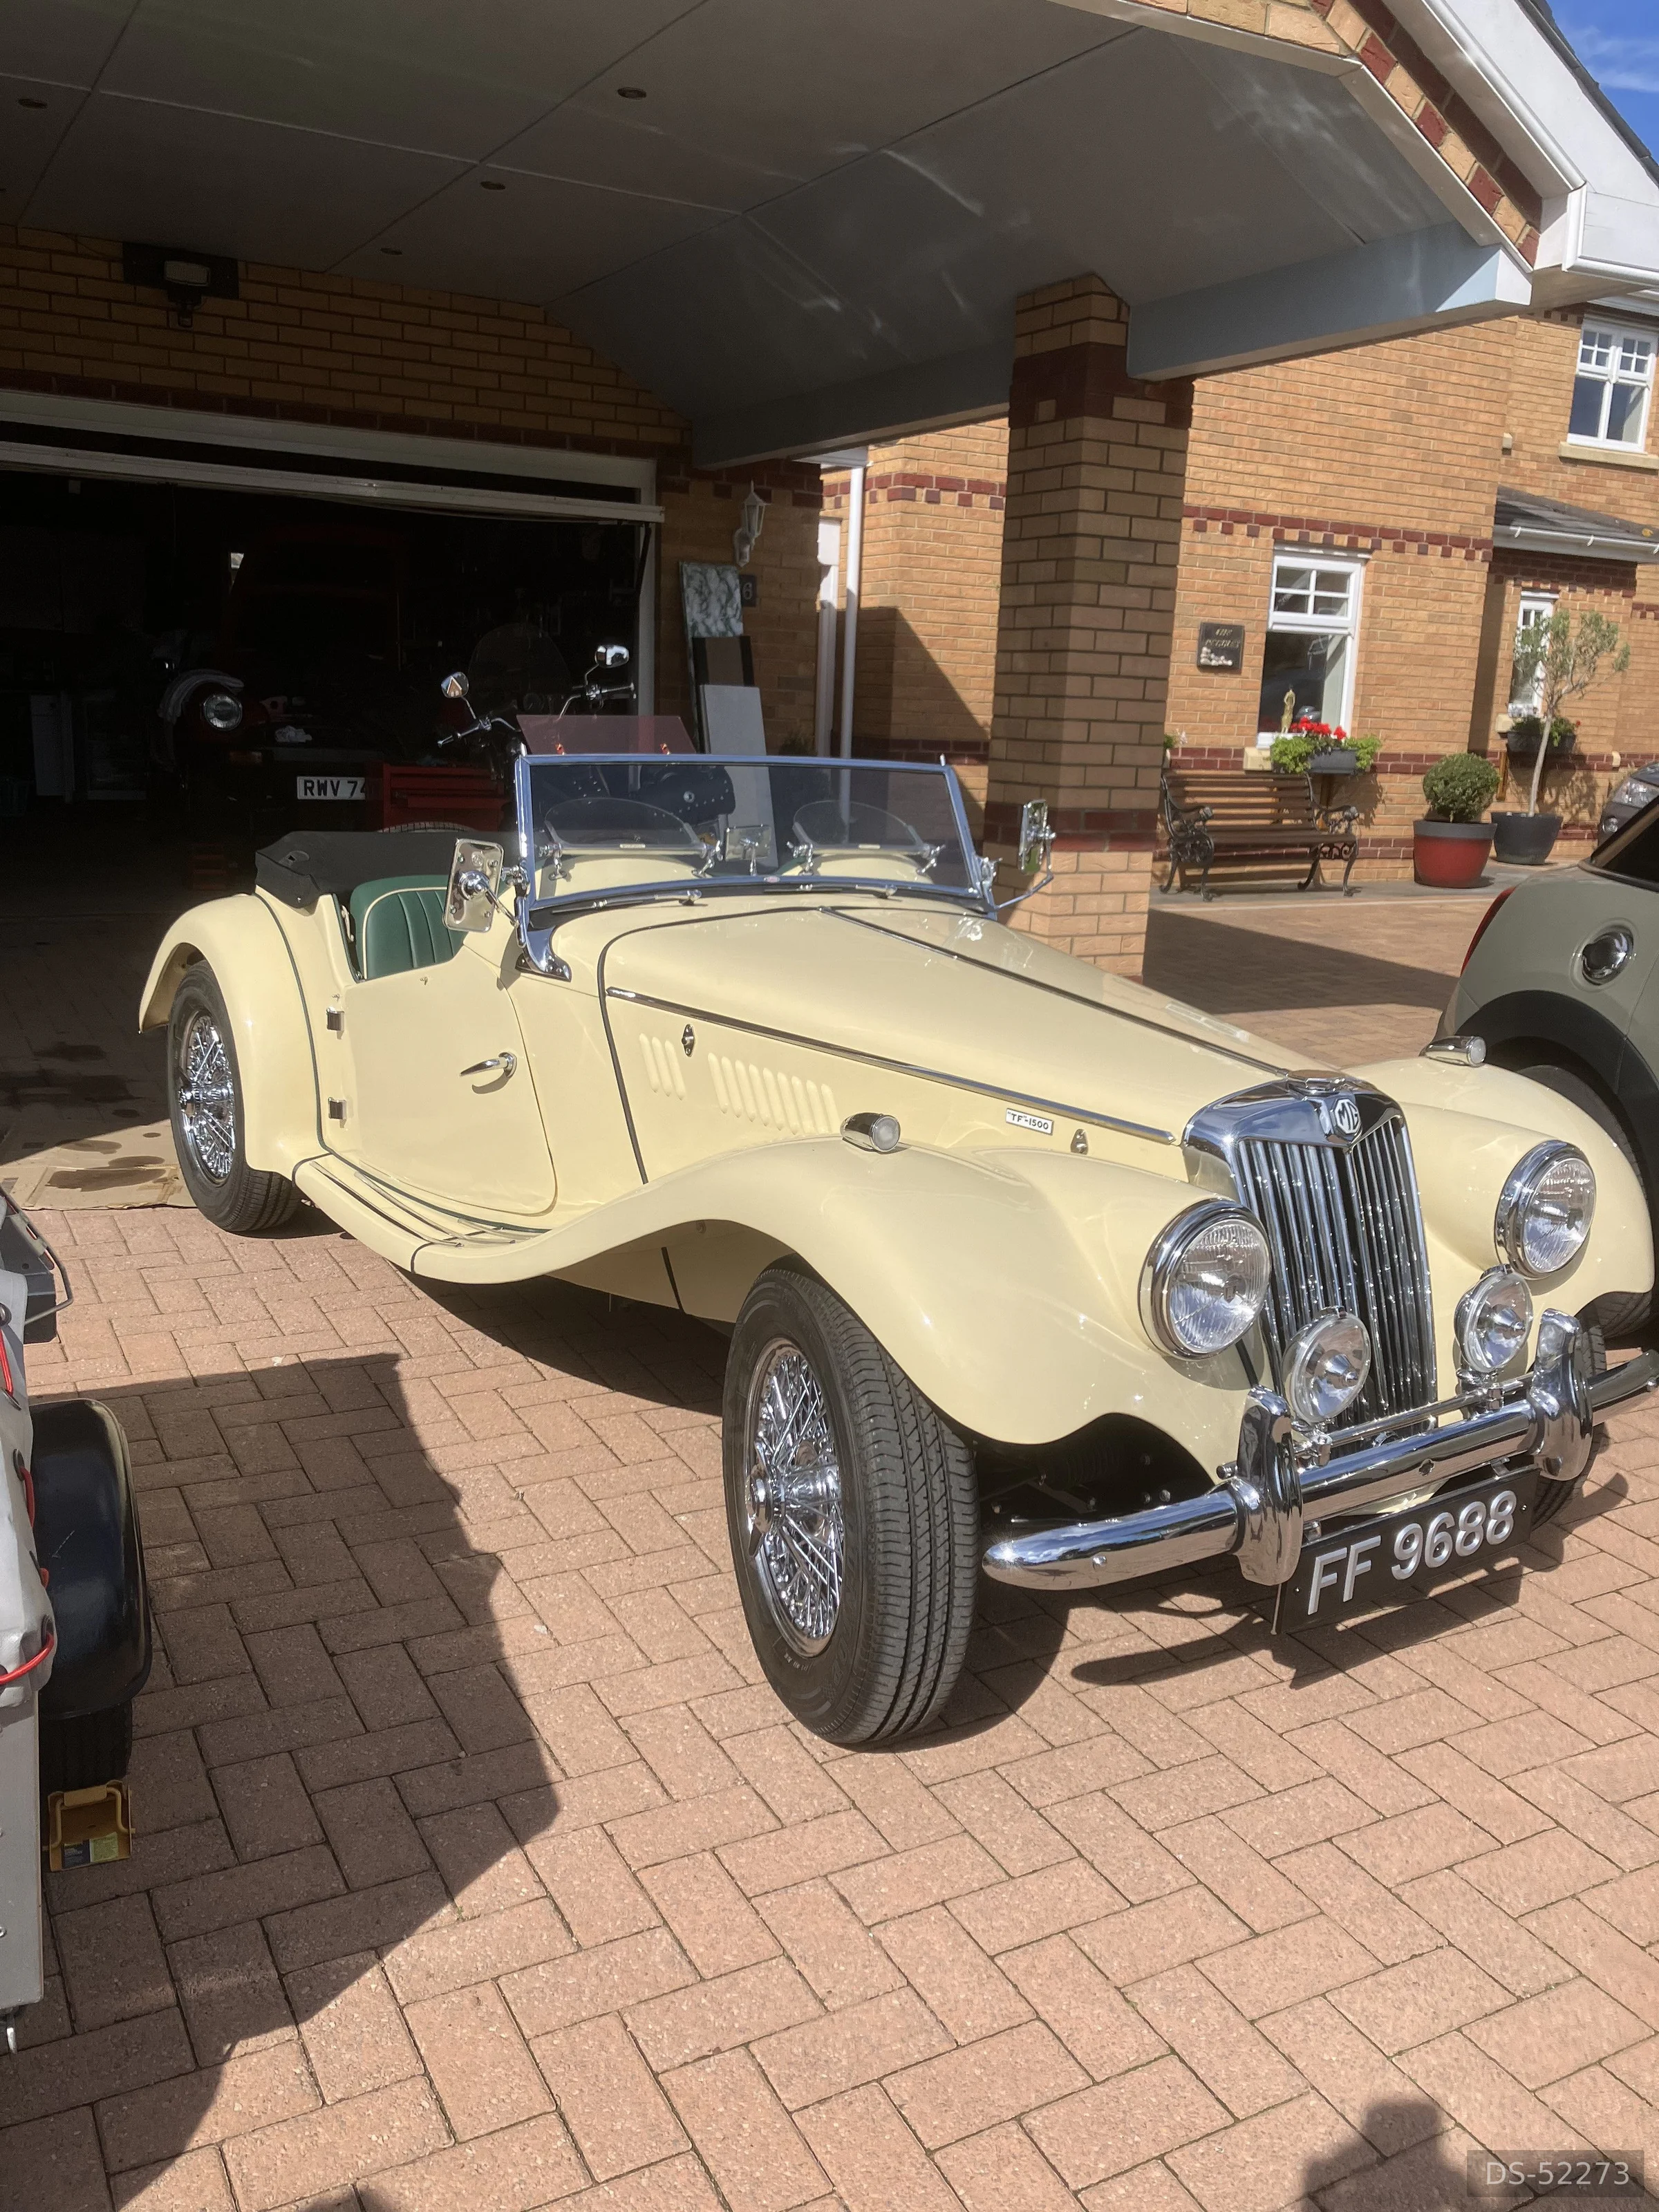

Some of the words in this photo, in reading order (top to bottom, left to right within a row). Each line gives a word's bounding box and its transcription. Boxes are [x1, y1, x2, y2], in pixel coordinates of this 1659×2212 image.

[303, 779, 340, 796] RWV
[1338, 1100, 1360, 1132] MG
[1307, 1535, 1382, 1615] FF
[1391, 1490, 1518, 1581] 9688
